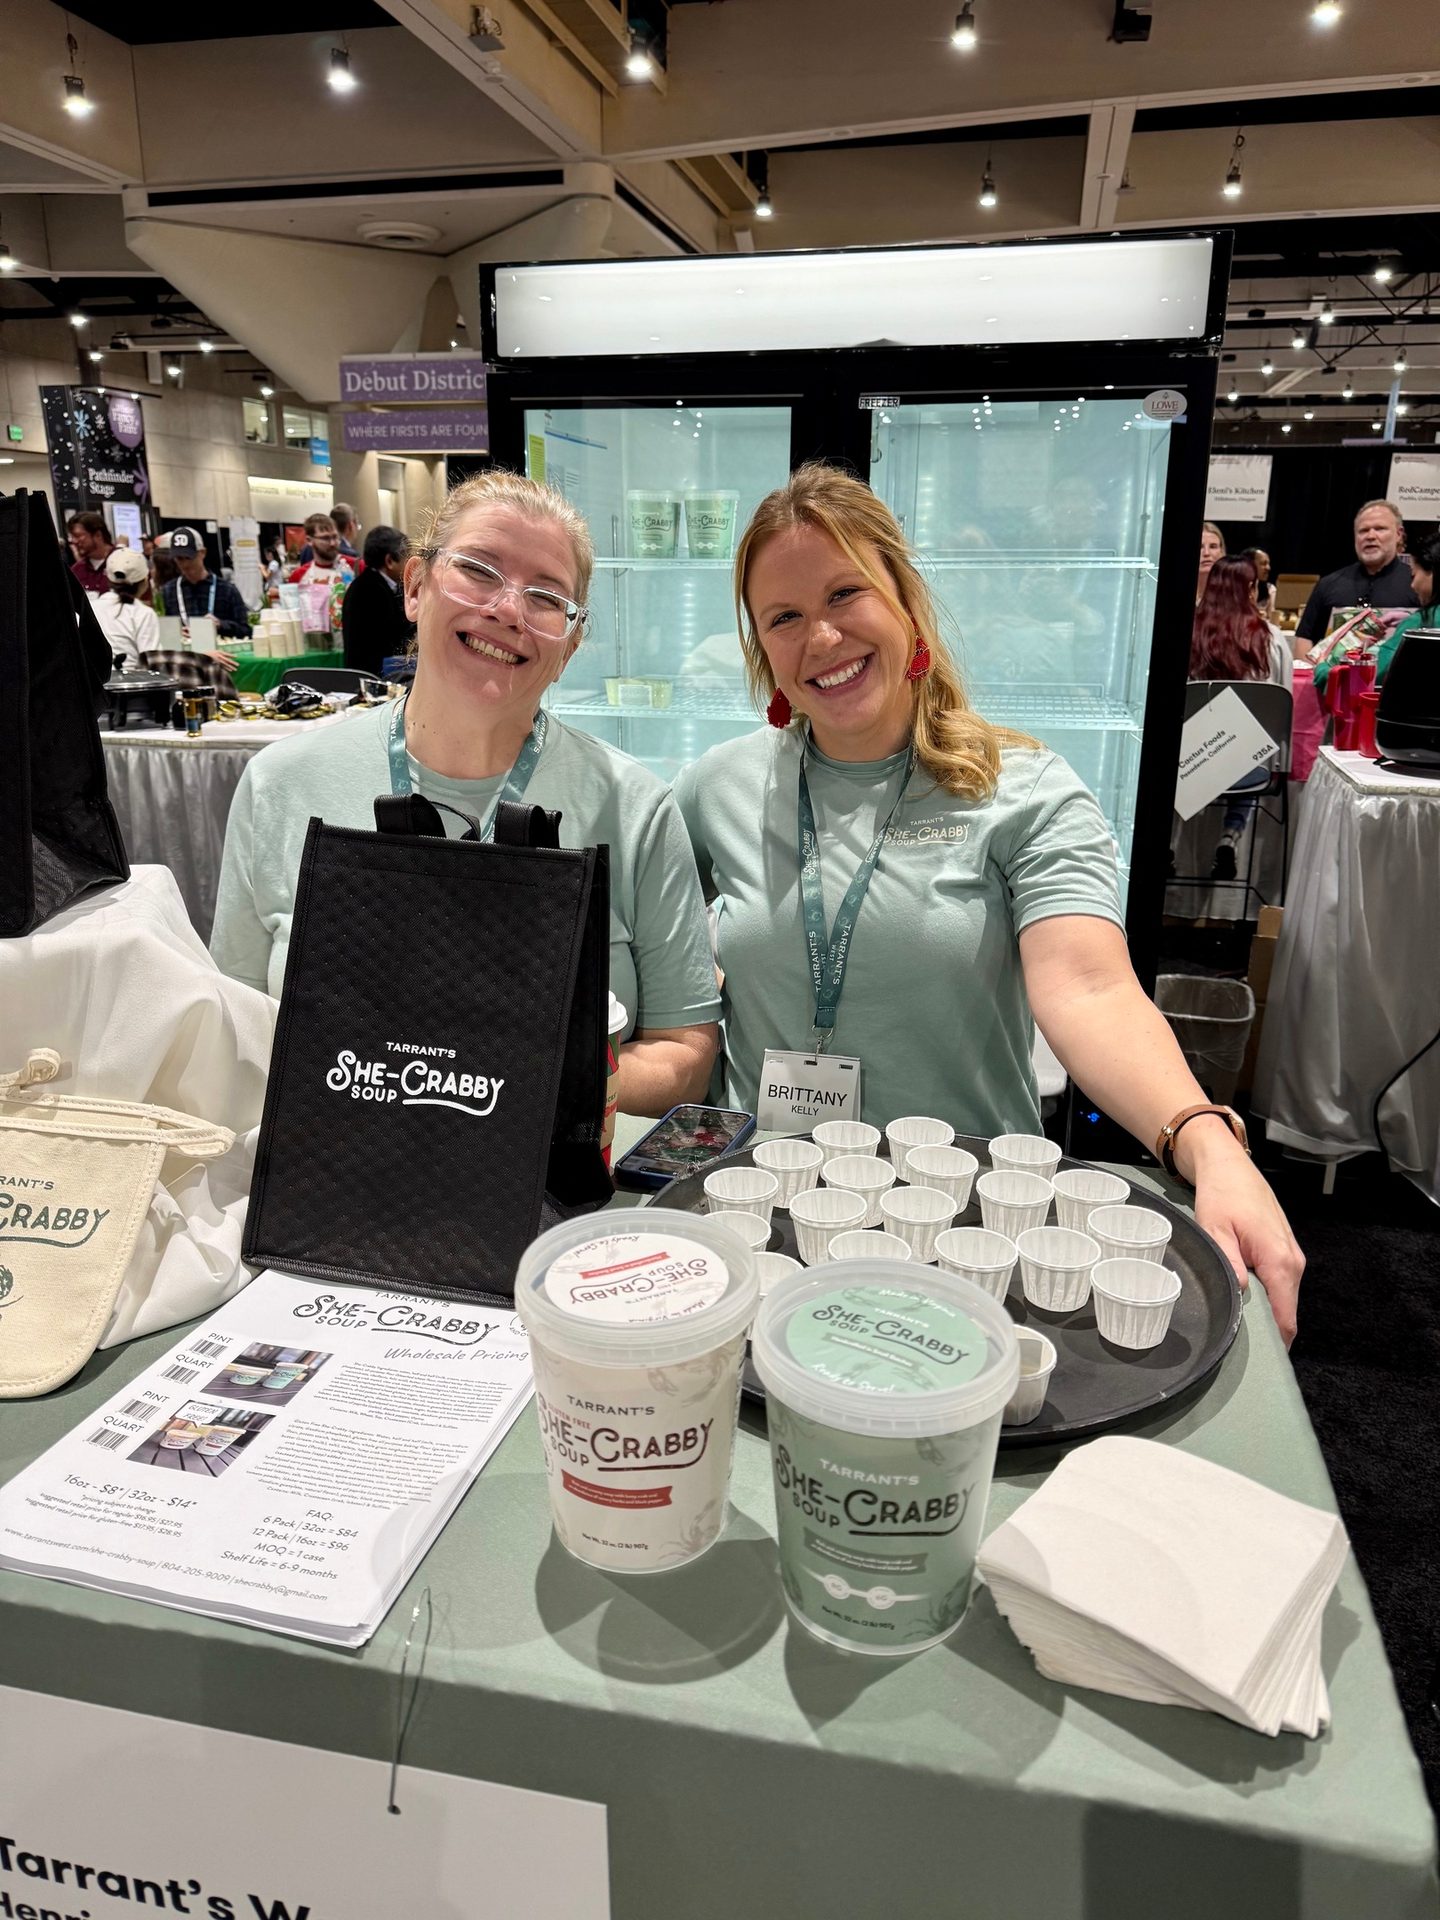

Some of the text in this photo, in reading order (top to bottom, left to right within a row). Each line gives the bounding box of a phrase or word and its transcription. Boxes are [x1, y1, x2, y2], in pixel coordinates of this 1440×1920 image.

[413, 370, 486, 391] Distric
[1152, 400, 1179, 410] LOWE
[348, 425, 388, 438] WHERE
[390, 425, 428, 437] FIRSTS
[430, 424, 452, 437] ARE
[88, 467, 134, 484] Pathfinder
[89, 481, 115, 498] Stage
[174, 534, 188, 546] SD
[1178, 730, 1226, 768] Cactus Foods
[1180, 734, 1237, 780] Pasadena, California
[1252, 744, 1274, 762] 935A
[910, 816, 944, 826] TARRANT'S
[885, 823, 970, 846] SHE-CRABBY
[808, 930, 822, 993] TARRANT'S
[832, 924, 852, 985] TARRANT'S
[386, 1041, 457, 1059] TARRANT'S
[326, 1050, 505, 1117] SHE-CRABBY
[351, 1084, 398, 1103] SOUP
[767, 1084, 848, 1108] BRITTANY
[791, 1104, 820, 1117] KELLY
[648, 1262, 684, 1276] SOUP
[570, 1258, 708, 1304] SHE-CRABBY
[375, 1291, 451, 1308] TARRANT'S
[292, 1294, 500, 1346] SHE-CRABBY
[314, 1316, 368, 1330] SOUP
[829, 1320, 870, 1334] SOUP
[874, 1308, 930, 1328] TARRANT'S
[208, 1332, 235, 1344] PINT
[812, 1304, 970, 1366] SHE-CRABBY
[175, 1354, 216, 1370] QUART
[384, 1348, 529, 1362] Wholesale Pricing
[142, 1390, 171, 1404] PINT
[566, 1394, 656, 1416] TARRANT'S
[102, 1416, 146, 1434] QUART
[550, 1435, 590, 1467] SOUP
[818, 1458, 920, 1486] TARRANT'S
[64, 1474, 90, 1489] 16oz
[128, 1490, 158, 1502] 32oz
[775, 1444, 980, 1537] SHE-CRABBY
[134, 1506, 156, 1515] change
[306, 1510, 334, 1522] FAQ:
[792, 1492, 841, 1528] SOUP
[263, 1516, 272, 1524] 6
[272, 1516, 296, 1528] Pack
[302, 1522, 326, 1534] 32oz
[336, 1528, 359, 1538] $84
[252, 1528, 264, 1536] 12
[265, 1530, 290, 1542] Pack
[296, 1536, 318, 1546] 16oz
[327, 1540, 350, 1552] $96
[254, 1542, 287, 1556] MOQ
[297, 1550, 304, 1558] 1
[302, 1554, 326, 1562] case
[220, 1550, 251, 1562] Shelf
[248, 1556, 269, 1567] Life
[278, 1562, 300, 1572] 6-9
[299, 1568, 338, 1580] months
[161, 1561, 231, 1582] 804-205-9009
[234, 1578, 328, 1601] shecrabby@gmail.com
[0, 1836, 235, 1920] Tarrant's
